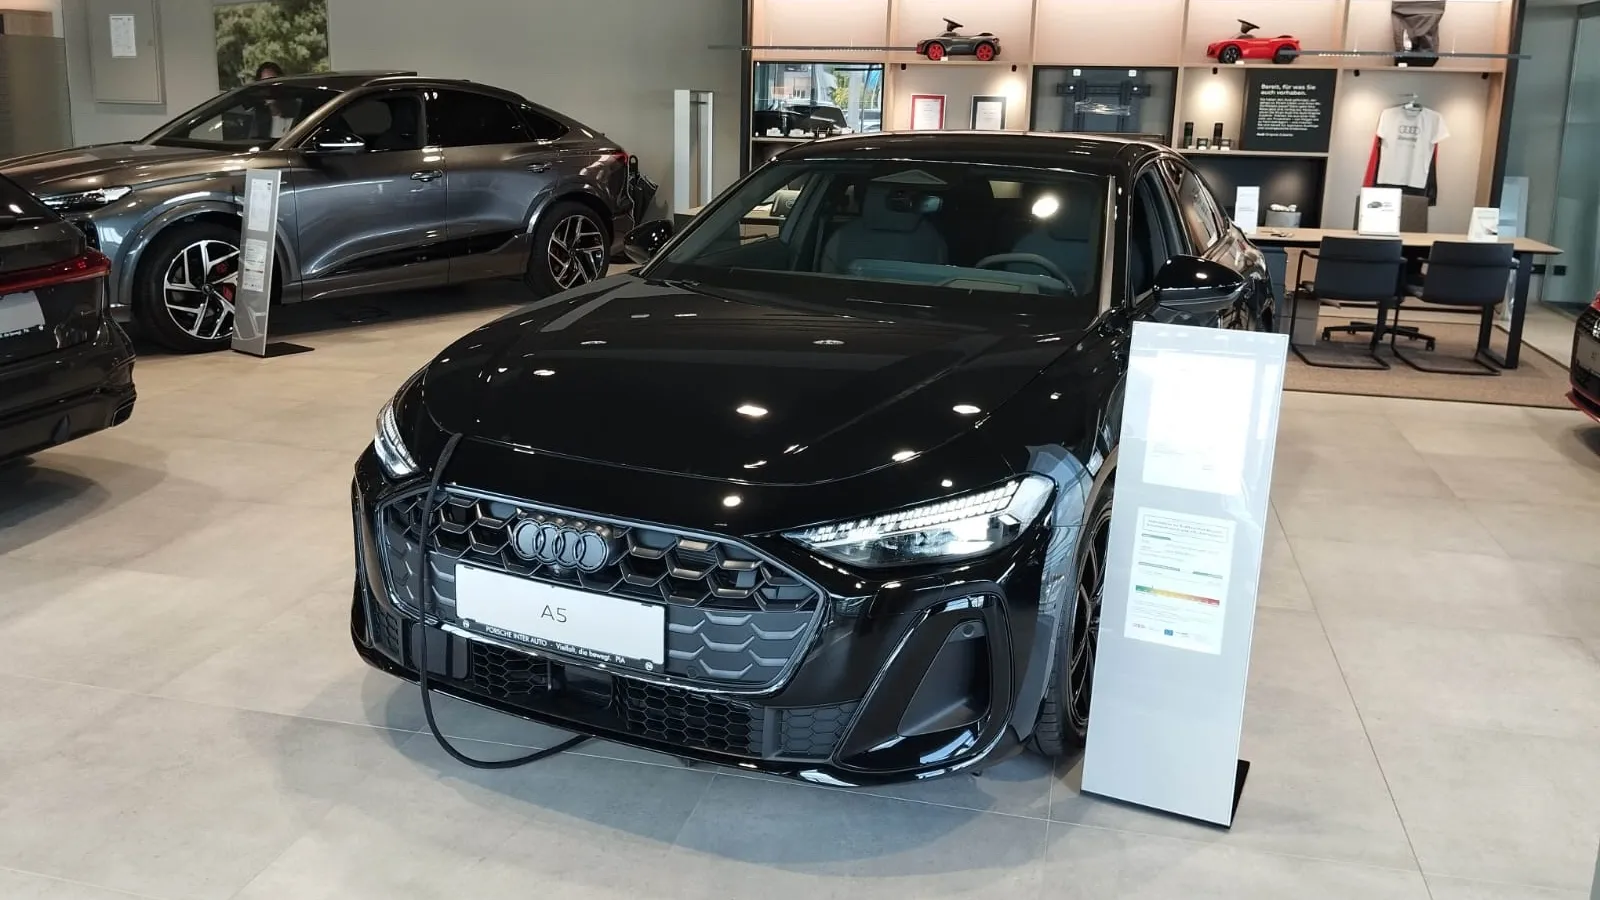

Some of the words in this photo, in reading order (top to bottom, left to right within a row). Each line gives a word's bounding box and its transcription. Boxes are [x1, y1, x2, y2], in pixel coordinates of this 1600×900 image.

[540, 604, 568, 623] A5
[485, 625, 512, 638] PORSCHE
[513, 632, 530, 643] INTER
[530, 637, 548, 647] AUTO
[555, 642, 577, 655] Vielfalt,
[578, 648, 588, 656] die
[615, 655, 626, 664] PIA
